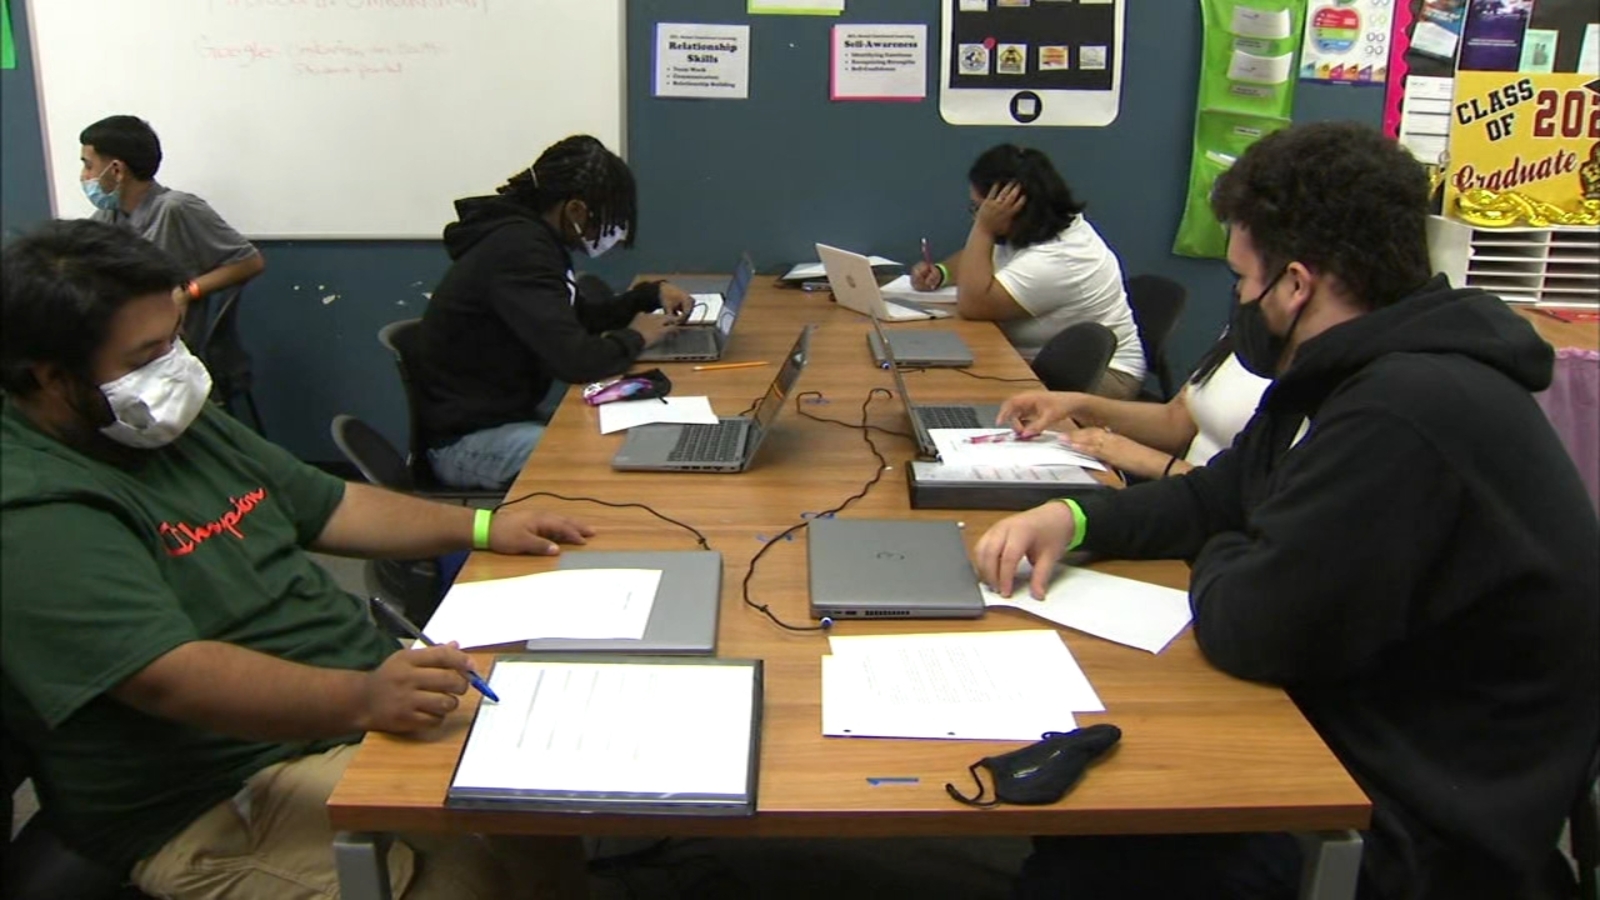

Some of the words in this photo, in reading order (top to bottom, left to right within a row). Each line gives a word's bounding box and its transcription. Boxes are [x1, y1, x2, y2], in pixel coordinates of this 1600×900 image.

[669, 42, 738, 53] Relationship
[844, 40, 918, 48] Self-Awareness
[687, 54, 719, 63] Skills
[1456, 79, 1534, 125] CLASS
[1486, 113, 1515, 141] OF
[1453, 149, 1577, 193] Graduate
